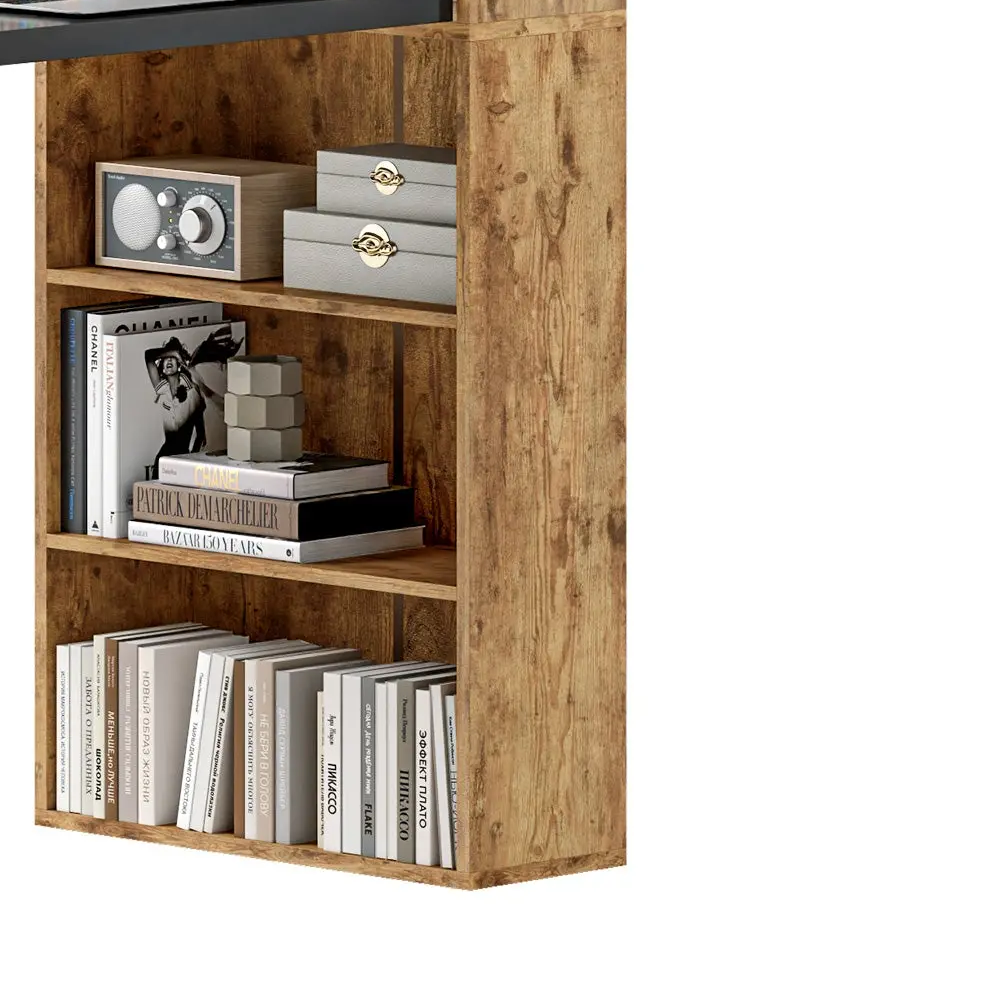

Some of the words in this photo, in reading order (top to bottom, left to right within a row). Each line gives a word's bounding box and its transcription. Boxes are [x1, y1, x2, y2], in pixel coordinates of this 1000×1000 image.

[90, 325, 98, 373] CHANEL
[193, 465, 240, 493] CHANEL
[136, 486, 184, 518] PATRICK
[188, 492, 279, 531] DEMARCHELIER
[163, 529, 201, 549] BAZAAR
[201, 535, 220, 551] 150
[219, 537, 264, 556] YEARS
[85, 676, 93, 715] ЗАБОТА
[142, 670, 151, 714] НОВЫЙ
[142, 717, 151, 755] ОБРАЗ
[215, 716, 226, 748] Религия
[259, 713, 270, 728] НЕ
[85, 729, 93, 795] ПРЕДАННЫХ
[259, 730, 270, 760] БЕРИ
[418, 729, 428, 783] ЭФФЕКТ
[142, 759, 151, 803] ЖИЗНИ
[259, 771, 270, 818] ГОЛОВУ
[327, 763, 338, 815] ПИКАССО
[364, 803, 373, 836] FLAKE
[399, 769, 410, 842] ПИКАССО
[418, 785, 428, 829] ПЛАТО
